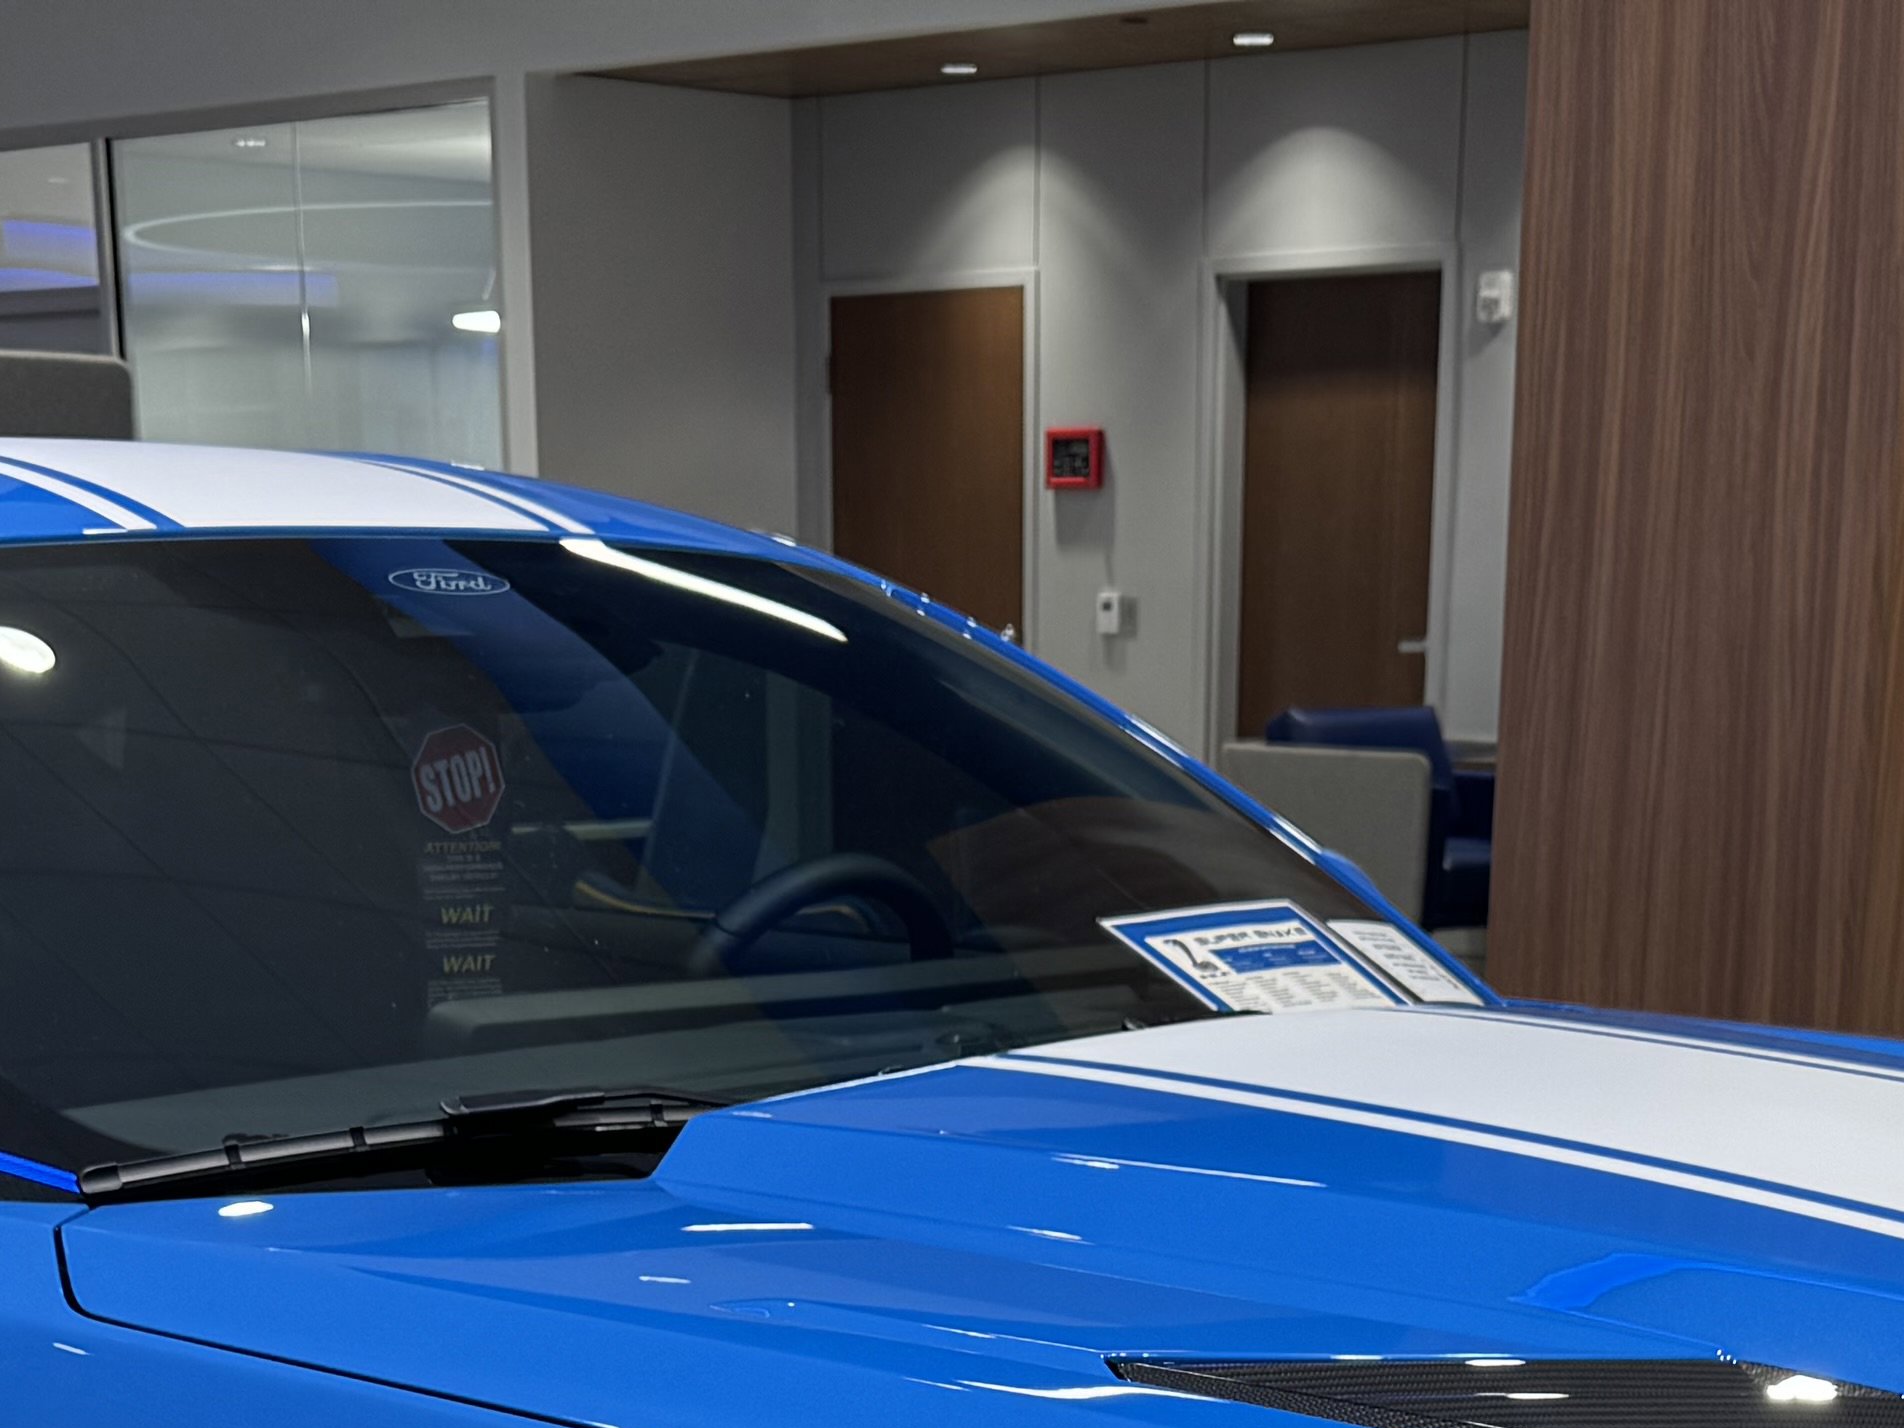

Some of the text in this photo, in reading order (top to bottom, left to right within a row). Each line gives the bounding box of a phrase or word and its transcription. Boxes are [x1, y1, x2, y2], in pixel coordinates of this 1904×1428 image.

[412, 571, 493, 592] Ford
[418, 745, 496, 813] STOP!
[440, 904, 495, 925] WAIT
[442, 954, 496, 974] WAIT
